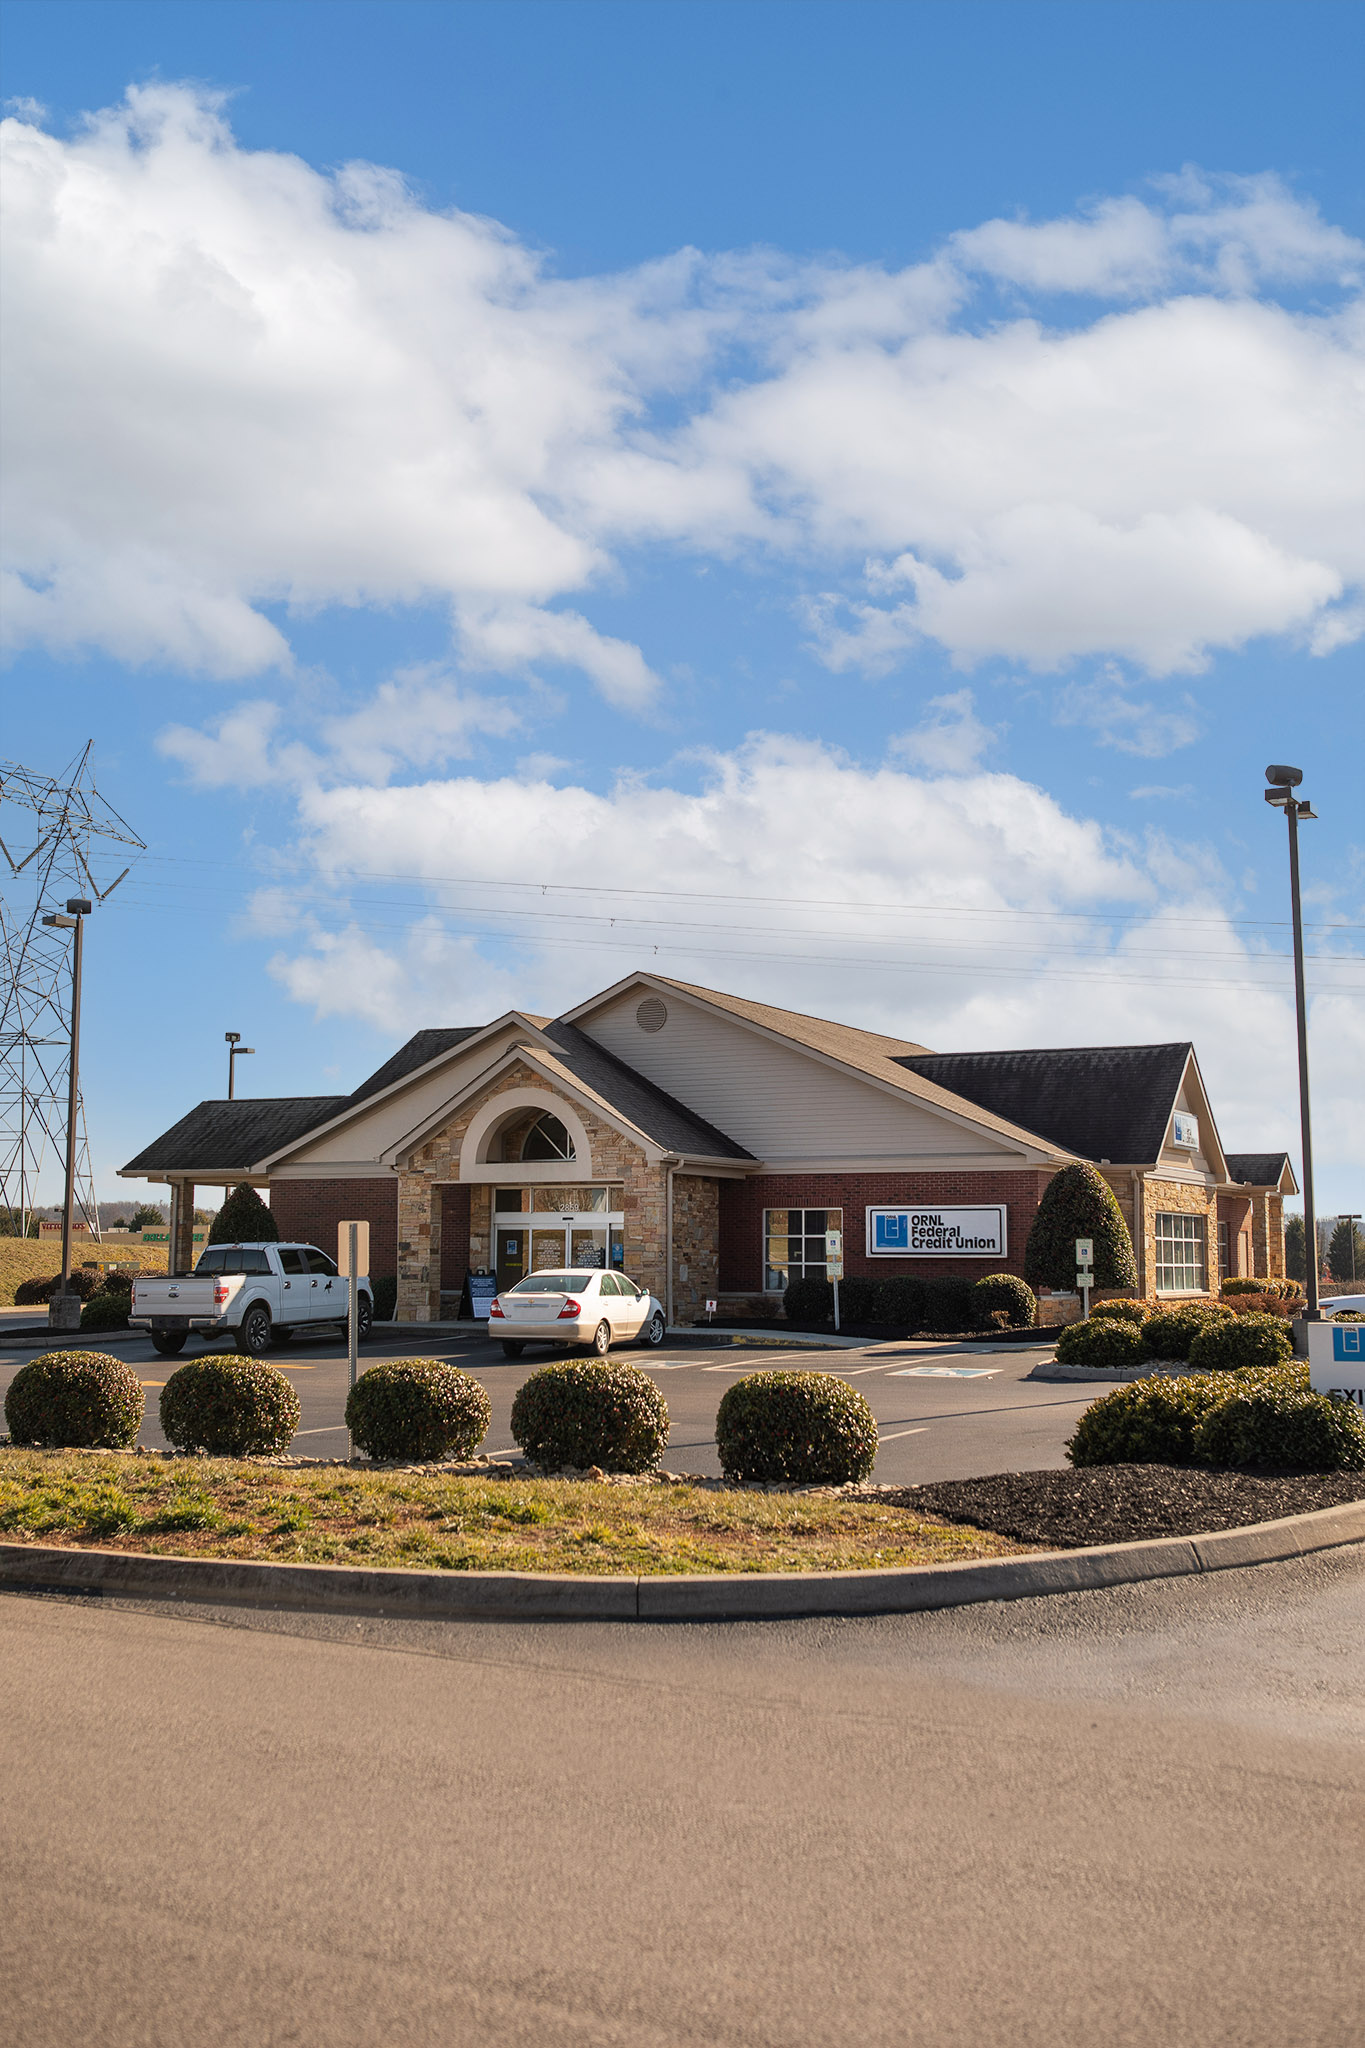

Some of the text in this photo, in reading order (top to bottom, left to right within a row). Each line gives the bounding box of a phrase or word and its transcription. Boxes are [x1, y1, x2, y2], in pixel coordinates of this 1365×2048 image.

[911, 1215, 944, 1226] ORNL
[911, 1226, 960, 1237] Federal
[143, 1233, 170, 1242] DOLLA
[911, 1237, 995, 1249] Credit Union
[1329, 1388, 1365, 1405] EXI
